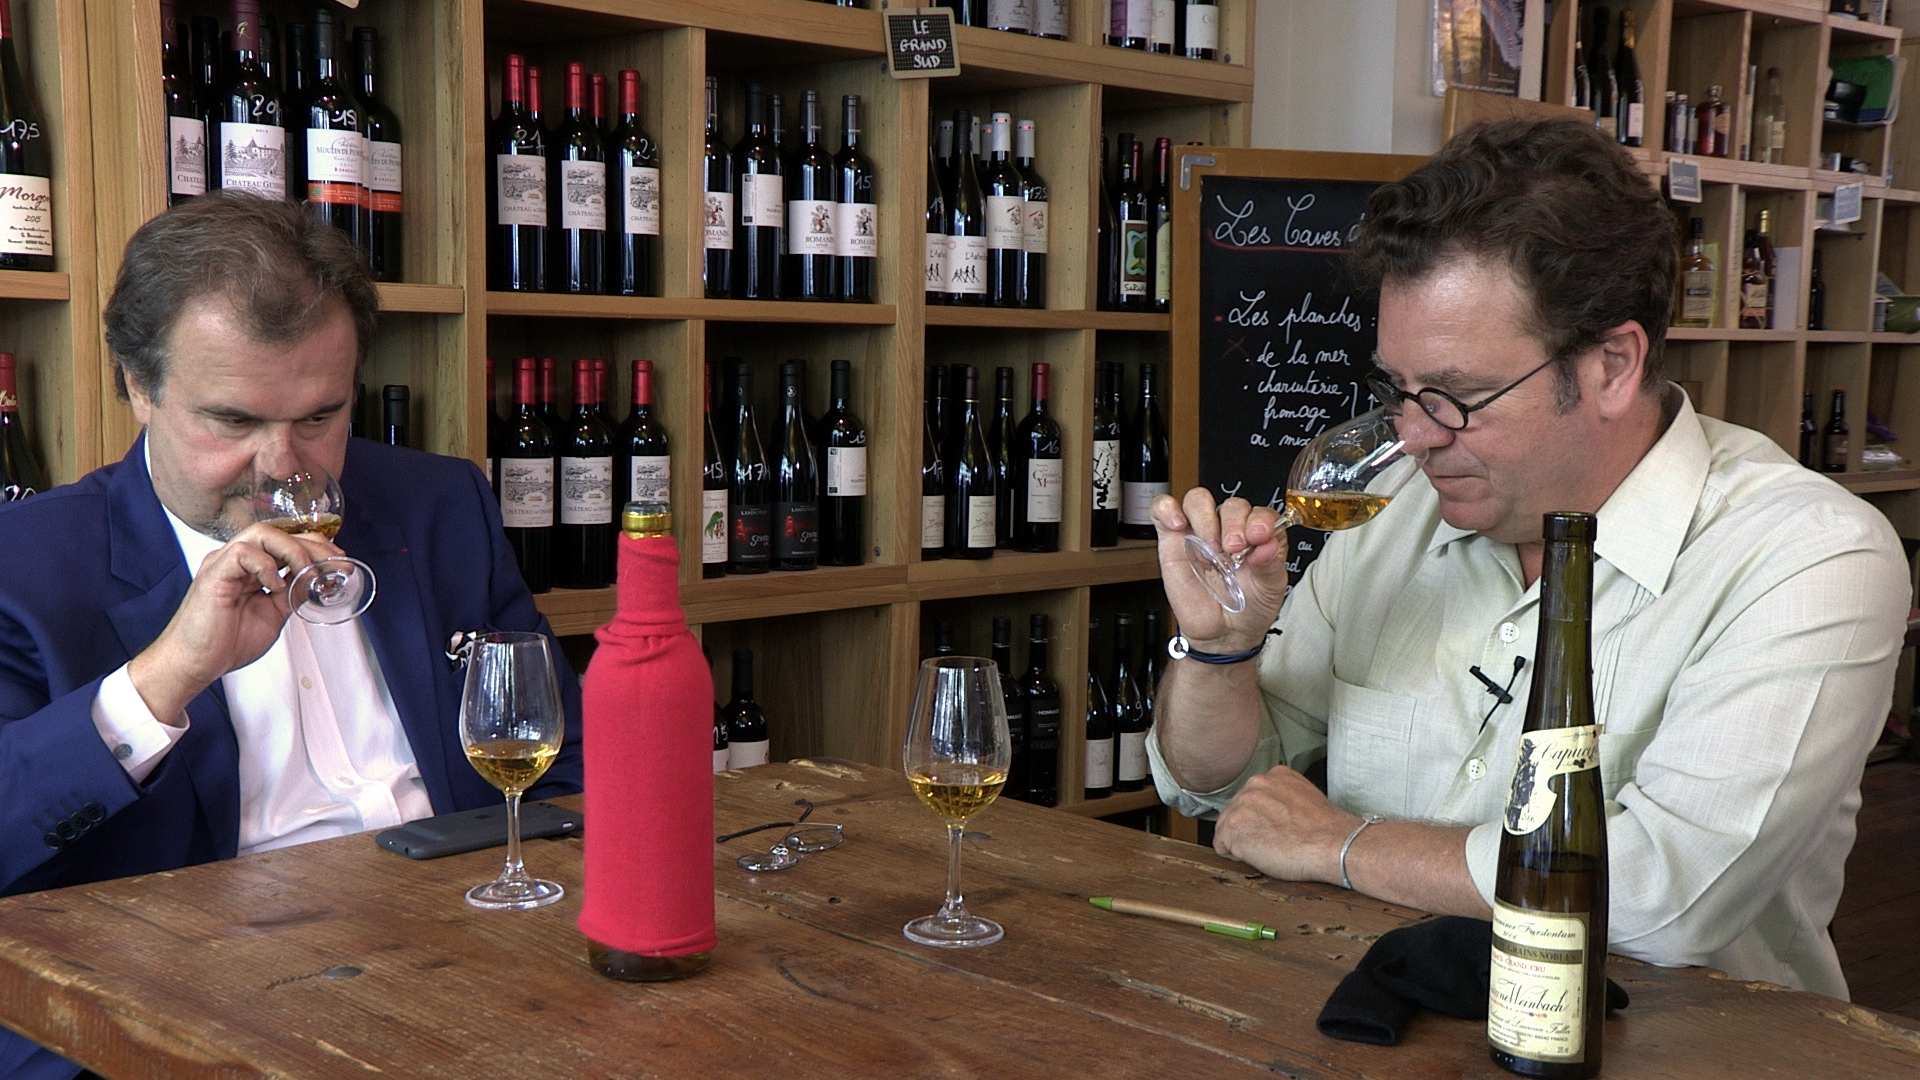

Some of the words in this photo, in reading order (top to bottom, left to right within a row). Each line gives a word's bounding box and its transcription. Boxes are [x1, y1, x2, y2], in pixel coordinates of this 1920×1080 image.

[912, 19, 930, 35] LE
[899, 38, 947, 53] GRAND
[913, 54, 941, 69] SUD
[250, 94, 276, 117] 20
[332, 109, 357, 127] 15
[0, 119, 40, 140] 17,5
[515, 129, 545, 149] 21
[226, 179, 262, 188] CHATEAU
[855, 175, 873, 190] 15
[1215, 194, 1271, 246] Les
[1284, 193, 1341, 246] Caves
[1228, 290, 1269, 327] Les
[1278, 292, 1361, 344] planches
[1257, 341, 1280, 367] de
[1286, 339, 1309, 365] la
[1315, 350, 1351, 366] mer
[1263, 395, 1331, 432] fromage
[849, 430, 866, 444] 15
[1250, 433, 1270, 447] ou
[704, 461, 723, 479] 15
[744, 463, 764, 481] 17
[1509, 945, 1537, 958] GRAINS
[1539, 951, 1576, 960] NOBLES
